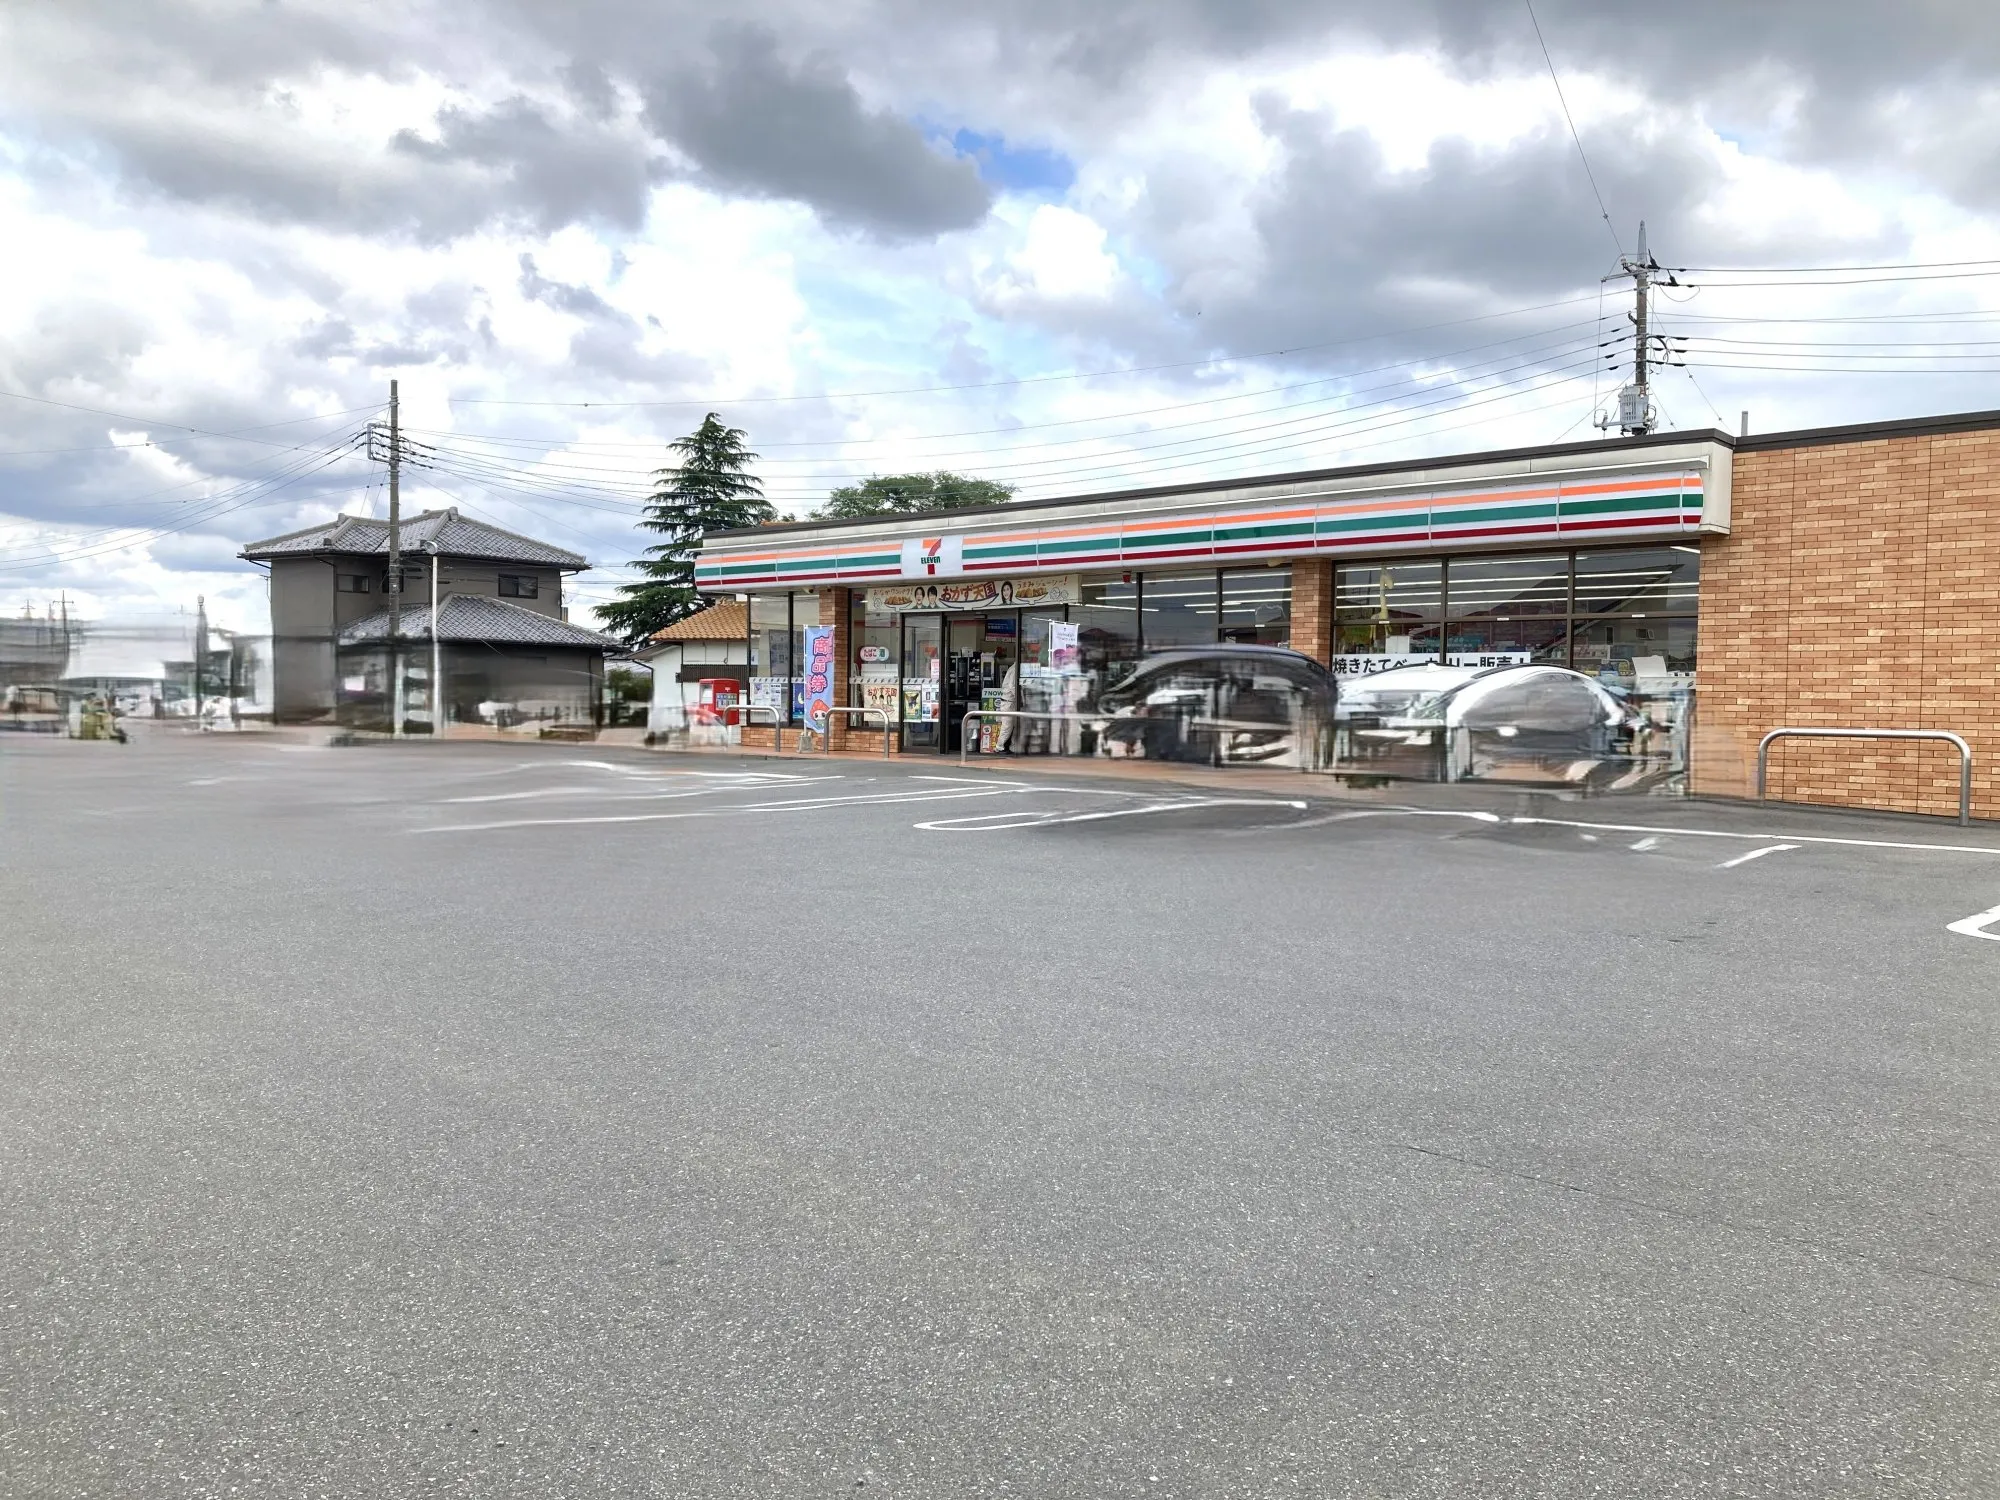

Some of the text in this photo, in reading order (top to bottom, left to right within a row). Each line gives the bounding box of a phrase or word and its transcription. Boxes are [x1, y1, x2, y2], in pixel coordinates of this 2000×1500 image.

[922, 538, 942, 575] 7
[940, 581, 996, 601] おかず天国
[863, 648, 877, 658] たばこ
[811, 637, 829, 693] 商品券
[1333, 655, 1525, 674] 焼きたてベリー販売
[867, 687, 897, 697] おかず天国
